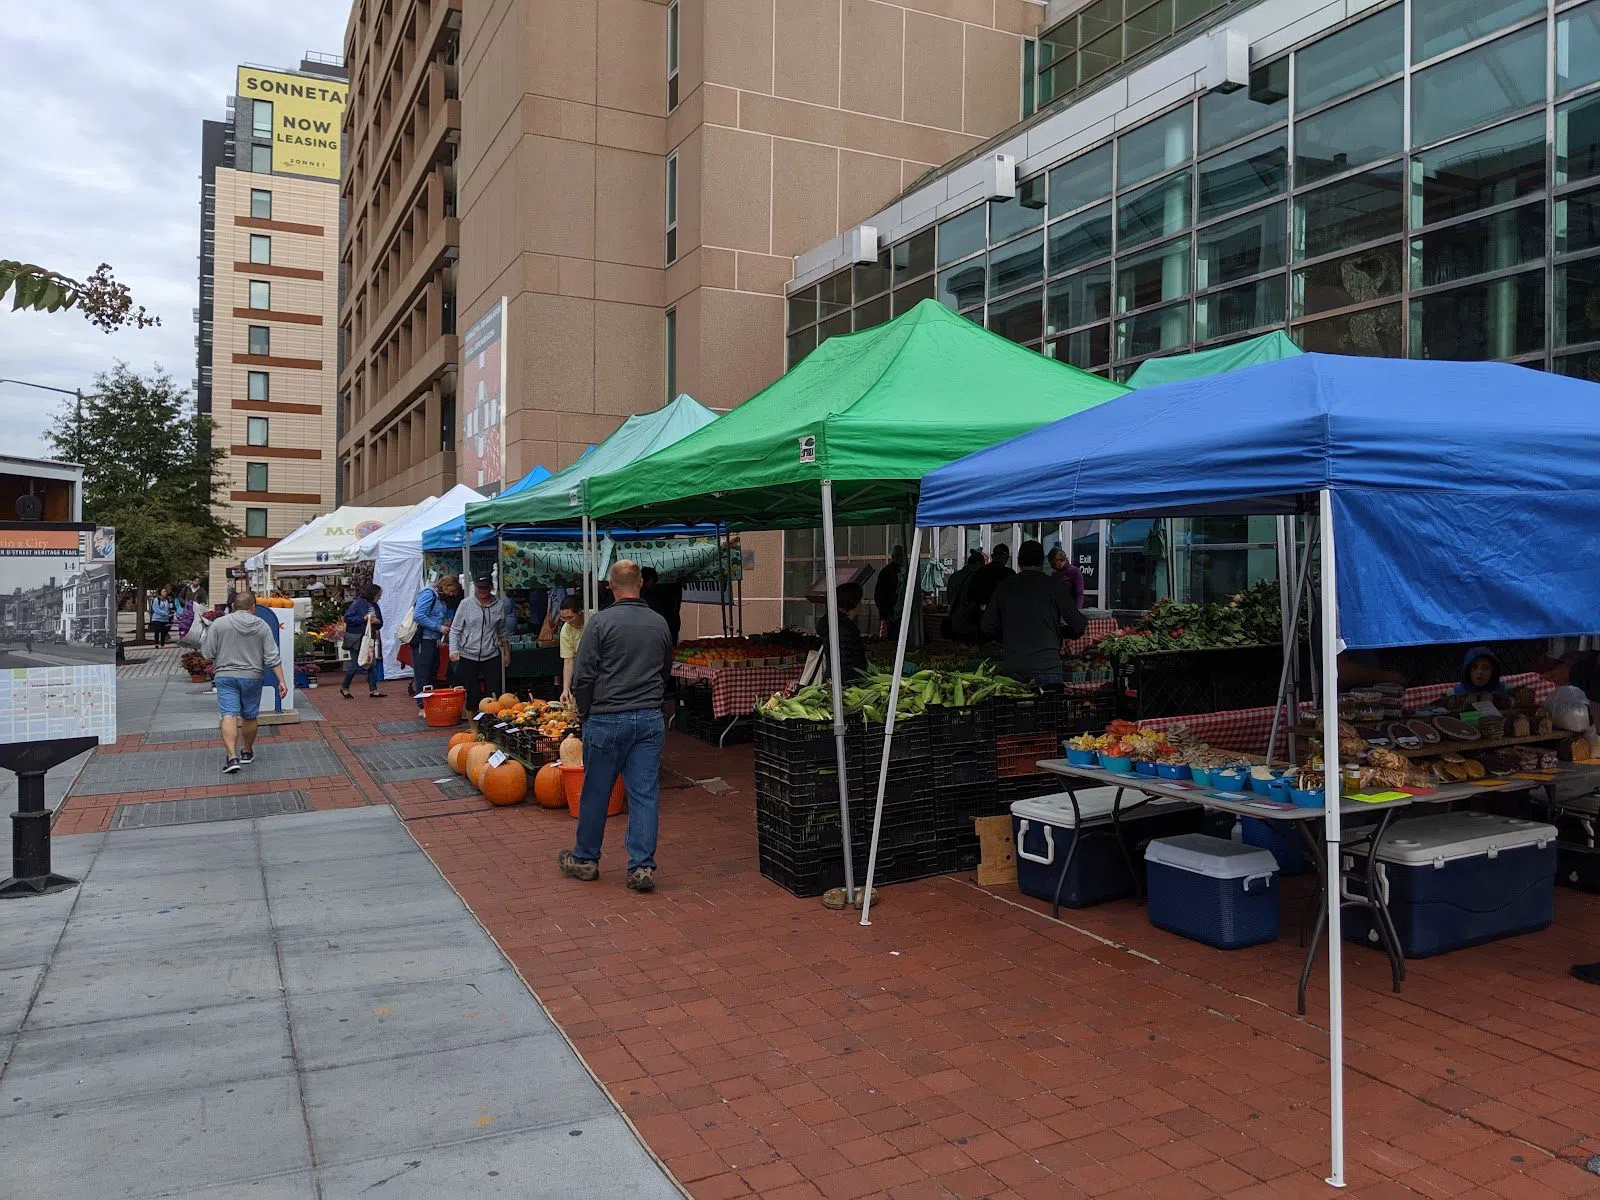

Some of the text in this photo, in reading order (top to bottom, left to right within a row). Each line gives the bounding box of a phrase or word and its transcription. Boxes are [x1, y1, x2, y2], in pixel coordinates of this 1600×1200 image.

[283, 115, 331, 134] NOW
[277, 133, 337, 150] LEASING
[290, 158, 326, 168] SONNET
[25, 536, 49, 550] City
[1079, 554, 1092, 564] Exit
[64, 562, 76, 570] 14
[1079, 565, 1095, 576] Only
